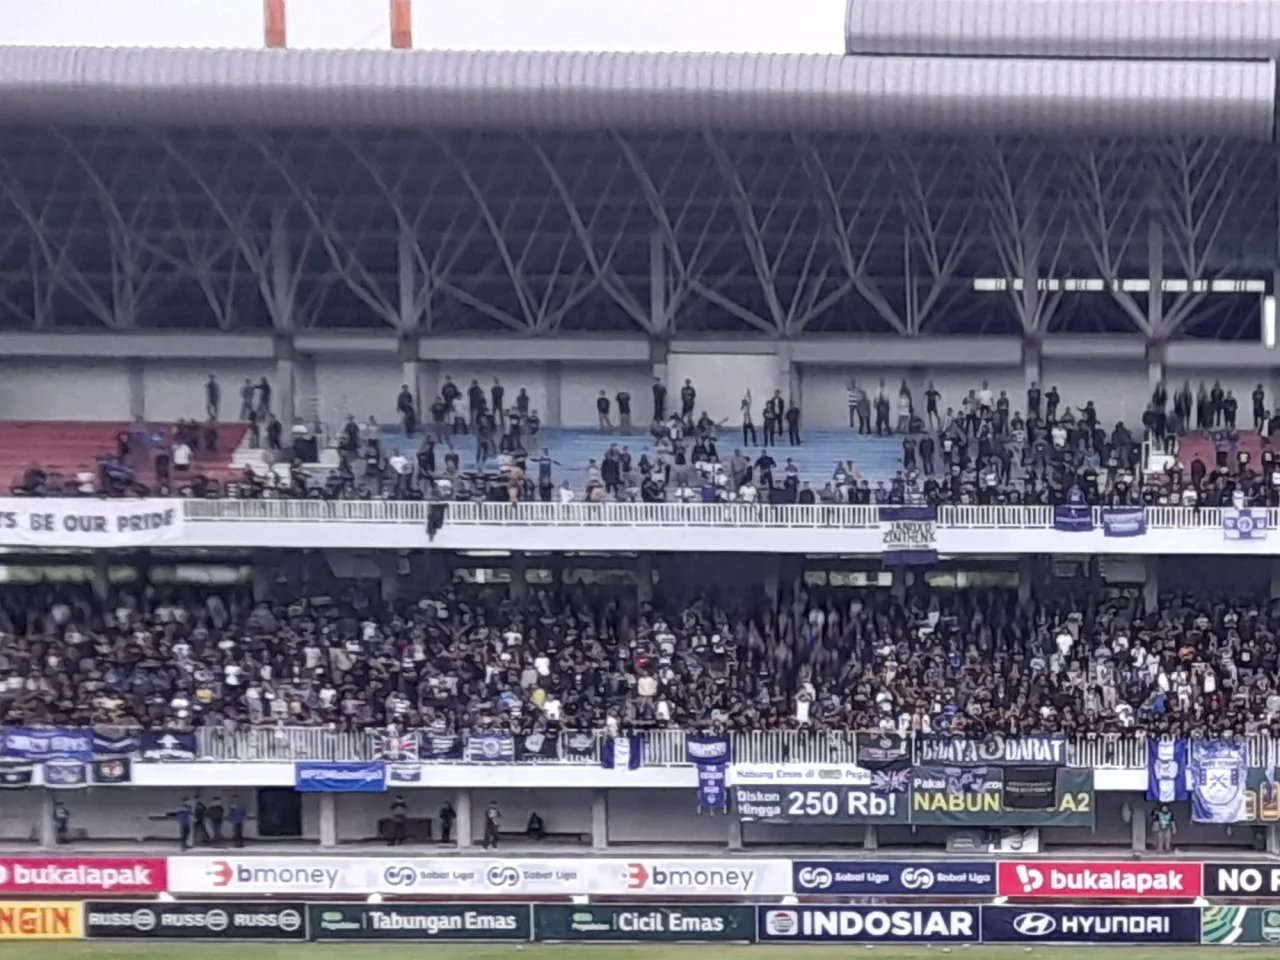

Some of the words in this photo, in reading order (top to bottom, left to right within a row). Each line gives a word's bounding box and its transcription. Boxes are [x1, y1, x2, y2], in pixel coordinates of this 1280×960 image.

[30, 513, 55, 532] BE
[62, 514, 107, 533] OUR
[116, 508, 175, 532] PRIDE
[1005, 738, 1065, 762] DARAT
[913, 778, 946, 789] Pakai
[736, 789, 780, 802] Diskon
[788, 791, 838, 816] 250
[847, 791, 896, 816] Rb!
[737, 803, 782, 817] Hingga
[14, 863, 152, 889] bukalapak
[237, 864, 340, 889] bmoney
[652, 866, 754, 890] bmoney
[867, 871, 890, 884] Liga
[968, 872, 991, 884] Liga
[1050, 868, 1184, 894] bukalapak
[1217, 868, 1262, 892] NO
[88, 912, 133, 926] RUSS
[161, 912, 205, 926] RUSS
[234, 912, 278, 926] RUSS
[369, 911, 463, 934] Tabungan
[464, 912, 517, 930] Emas
[618, 912, 665, 931] Cicil
[669, 912, 724, 932] Emas
[803, 910, 973, 936] INDOSIAR
[1062, 916, 1170, 933] HYUNDAI
